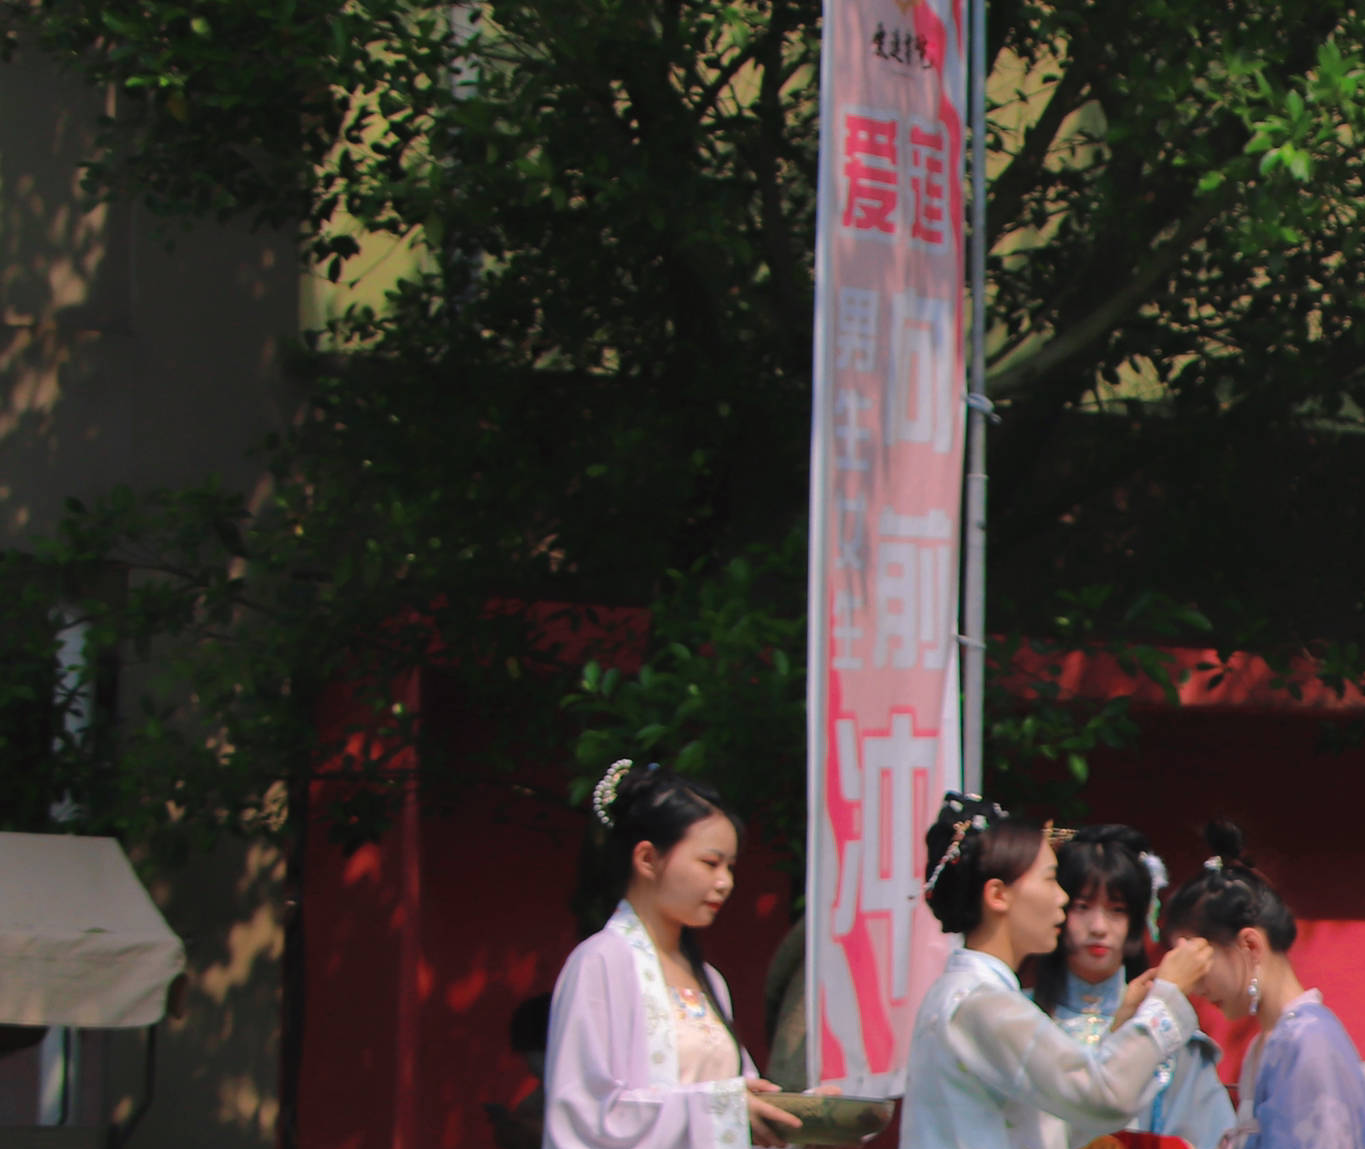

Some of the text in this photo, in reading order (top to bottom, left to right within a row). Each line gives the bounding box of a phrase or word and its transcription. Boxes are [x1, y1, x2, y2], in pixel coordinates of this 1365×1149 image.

[842, 114, 944, 244] 爱莲
[832, 285, 880, 671] 男生女生
[834, 287, 953, 1001] 向前冲
